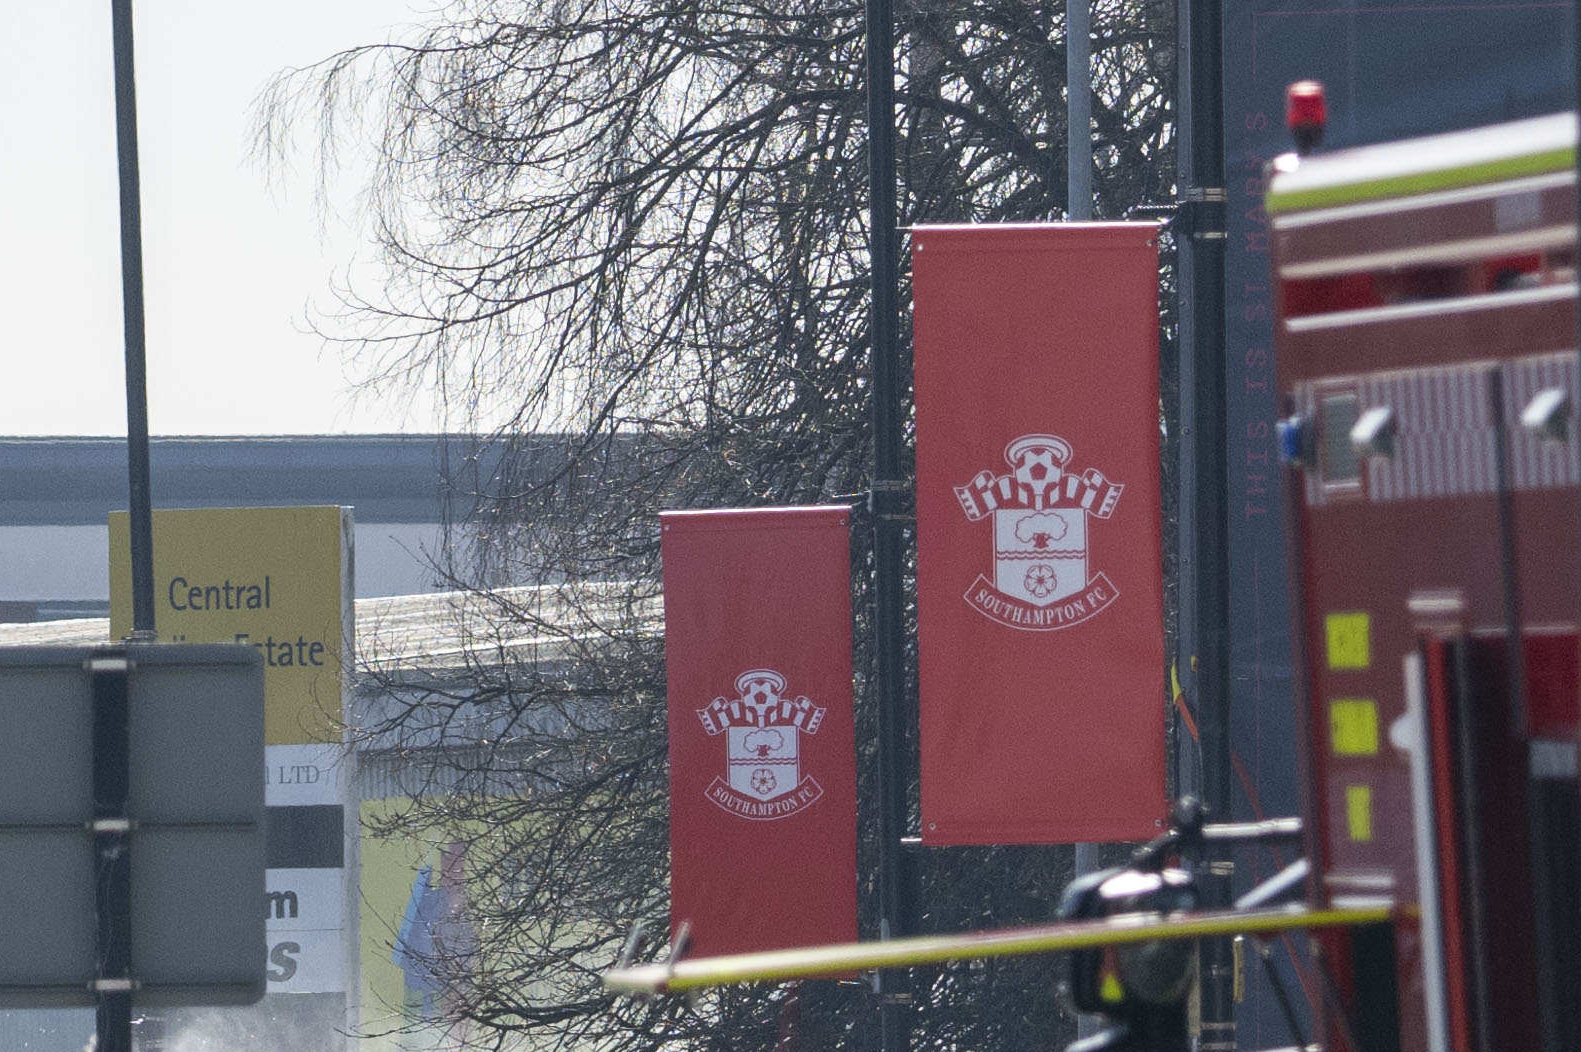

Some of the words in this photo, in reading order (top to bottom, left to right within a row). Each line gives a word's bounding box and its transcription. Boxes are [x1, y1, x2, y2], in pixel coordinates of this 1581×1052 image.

[1244, 348, 1268, 395] IS
[1245, 421, 1268, 521] THIS
[170, 576, 270, 611] Central
[975, 588, 1087, 626] SOUTHAMPTON
[1087, 586, 1108, 608] FC
[279, 765, 320, 785] LTD
[713, 786, 798, 816] SOUTHAMPTON
[798, 786, 814, 803] FC
